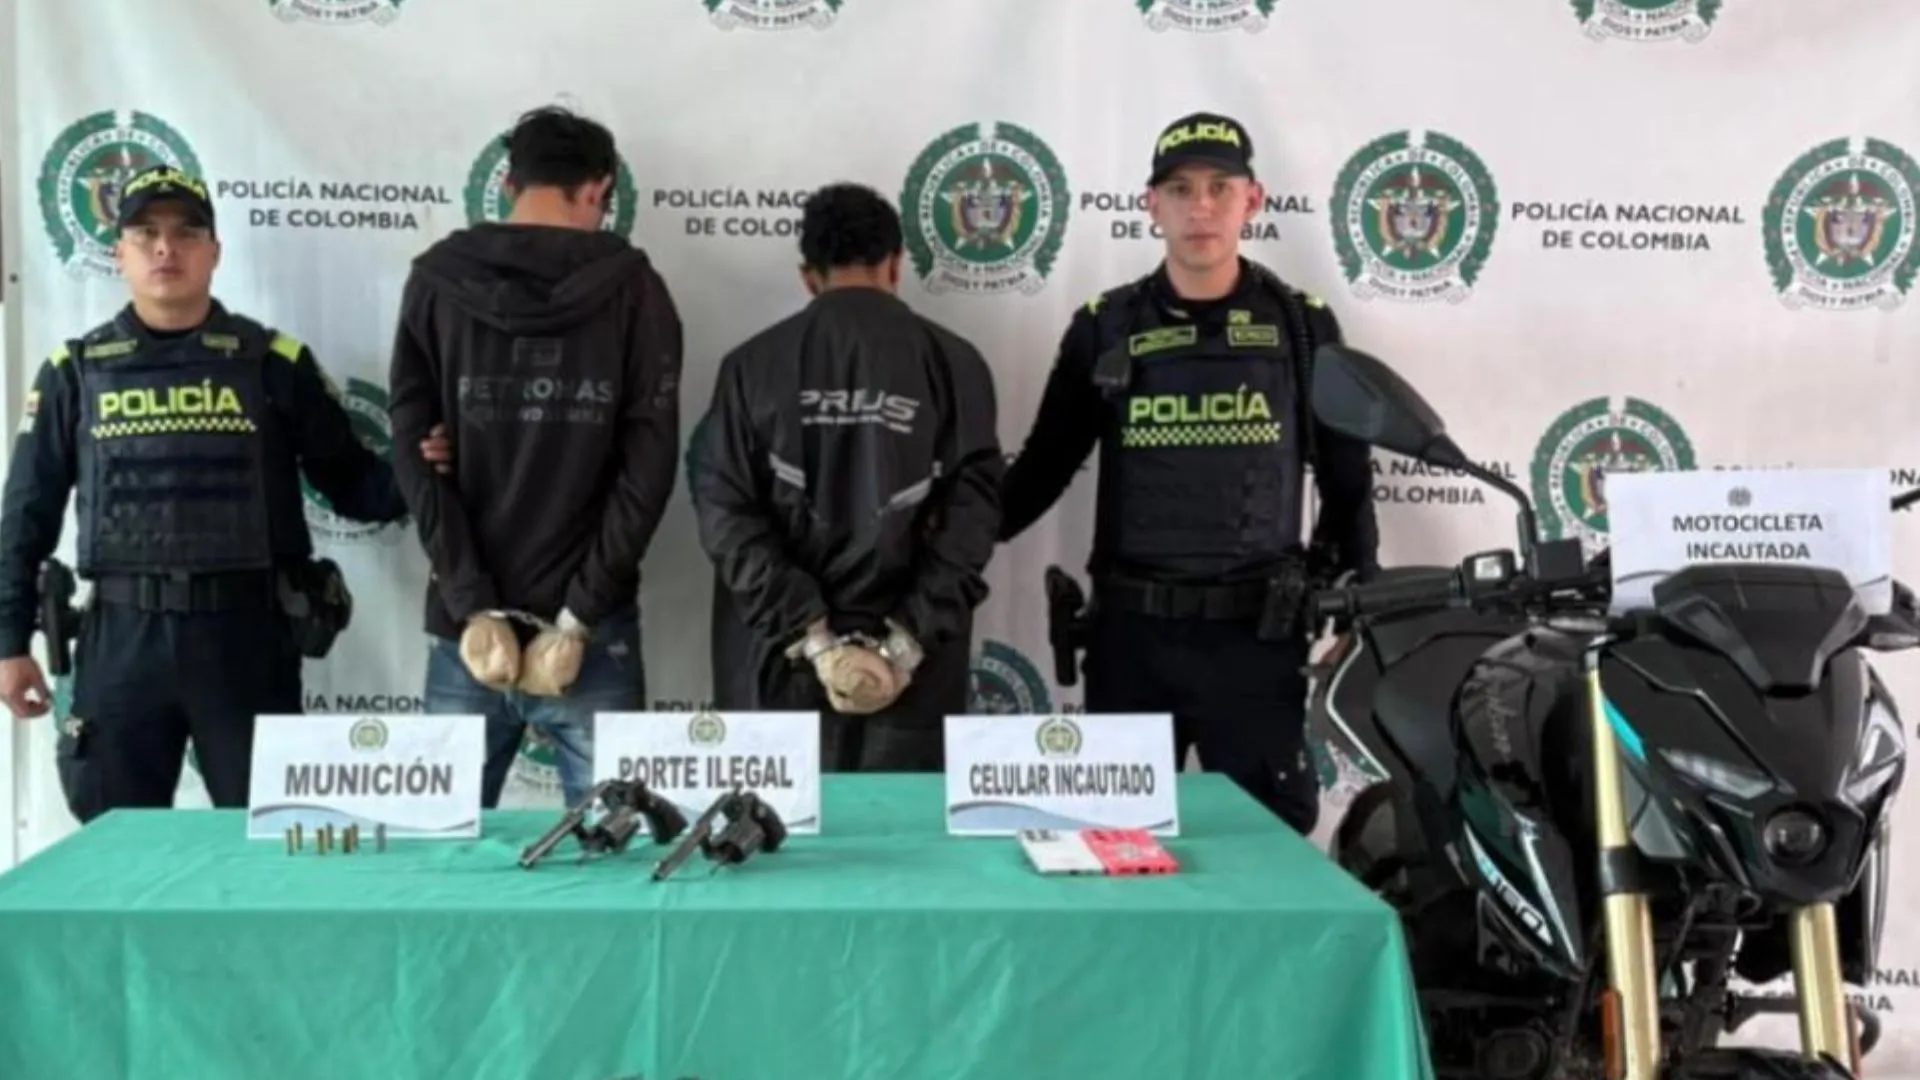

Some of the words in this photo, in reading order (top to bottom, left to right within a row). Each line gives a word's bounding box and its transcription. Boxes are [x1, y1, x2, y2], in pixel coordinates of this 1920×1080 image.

[1159, 120, 1240, 156] POLICÍA
[217, 177, 313, 199] POLICÍA
[320, 182, 453, 204] NACIONAL
[653, 185, 751, 208] POLICÍA
[1080, 192, 1150, 211] POLIC
[249, 208, 281, 227] DE
[287, 209, 419, 230] COLOMBIA
[1511, 199, 1608, 221] POLICÍA
[1615, 203, 1745, 224] NACIONAL
[685, 217, 717, 235] DE
[723, 218, 804, 236] COLO
[1111, 221, 1143, 239] DE
[1542, 229, 1573, 248] DE
[1580, 230, 1711, 250] COLOMBIA
[98, 378, 242, 419] POLICÍA
[1129, 382, 1271, 424] POLICÍA
[1373, 485, 1485, 504] OLOMBIA
[1672, 513, 1824, 533] MOTOCICLETA
[1686, 541, 1812, 560] INCAUTADA
[336, 694, 427, 713] NACION
[285, 756, 453, 797] MUNICIÓN
[618, 755, 699, 789] PORTE
[706, 755, 794, 789] ILEGAL
[969, 763, 1051, 796] CELULAR
[1054, 763, 1156, 796] INCAUTADO
